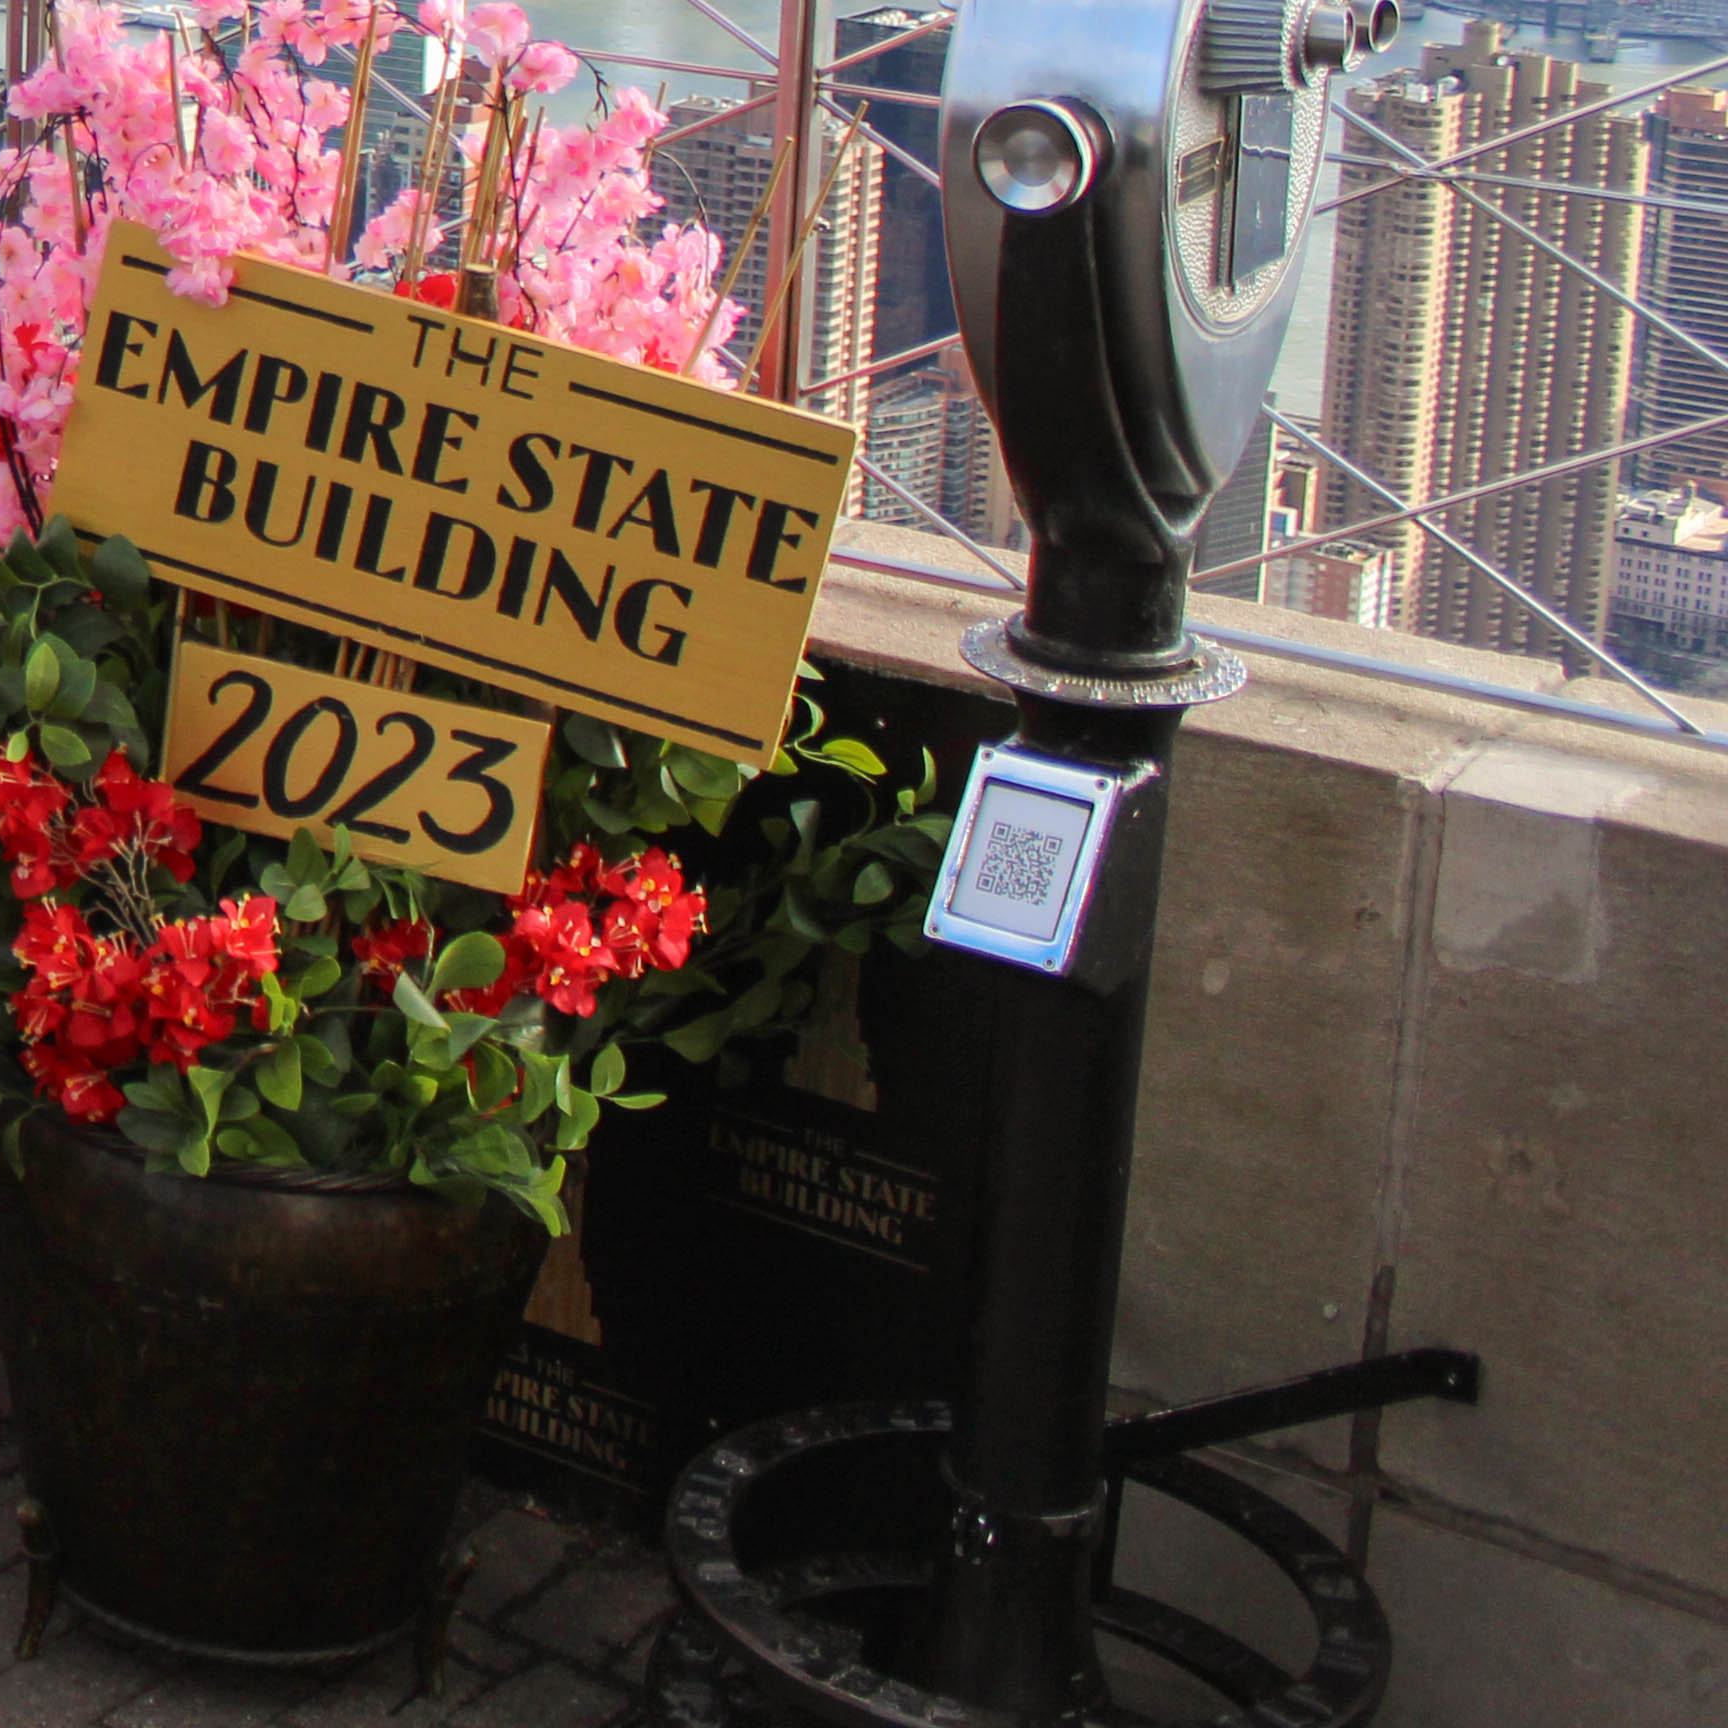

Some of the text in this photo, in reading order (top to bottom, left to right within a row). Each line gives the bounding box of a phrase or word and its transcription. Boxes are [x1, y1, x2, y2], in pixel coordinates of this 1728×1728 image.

[408, 315, 544, 399] THE
[95, 310, 819, 594] EMPIRE STATE
[174, 439, 693, 667] BUILDING
[173, 670, 518, 855] 2023
[740, 1167, 903, 1246] BUILDING
[839, 1167, 937, 1223] STATE
